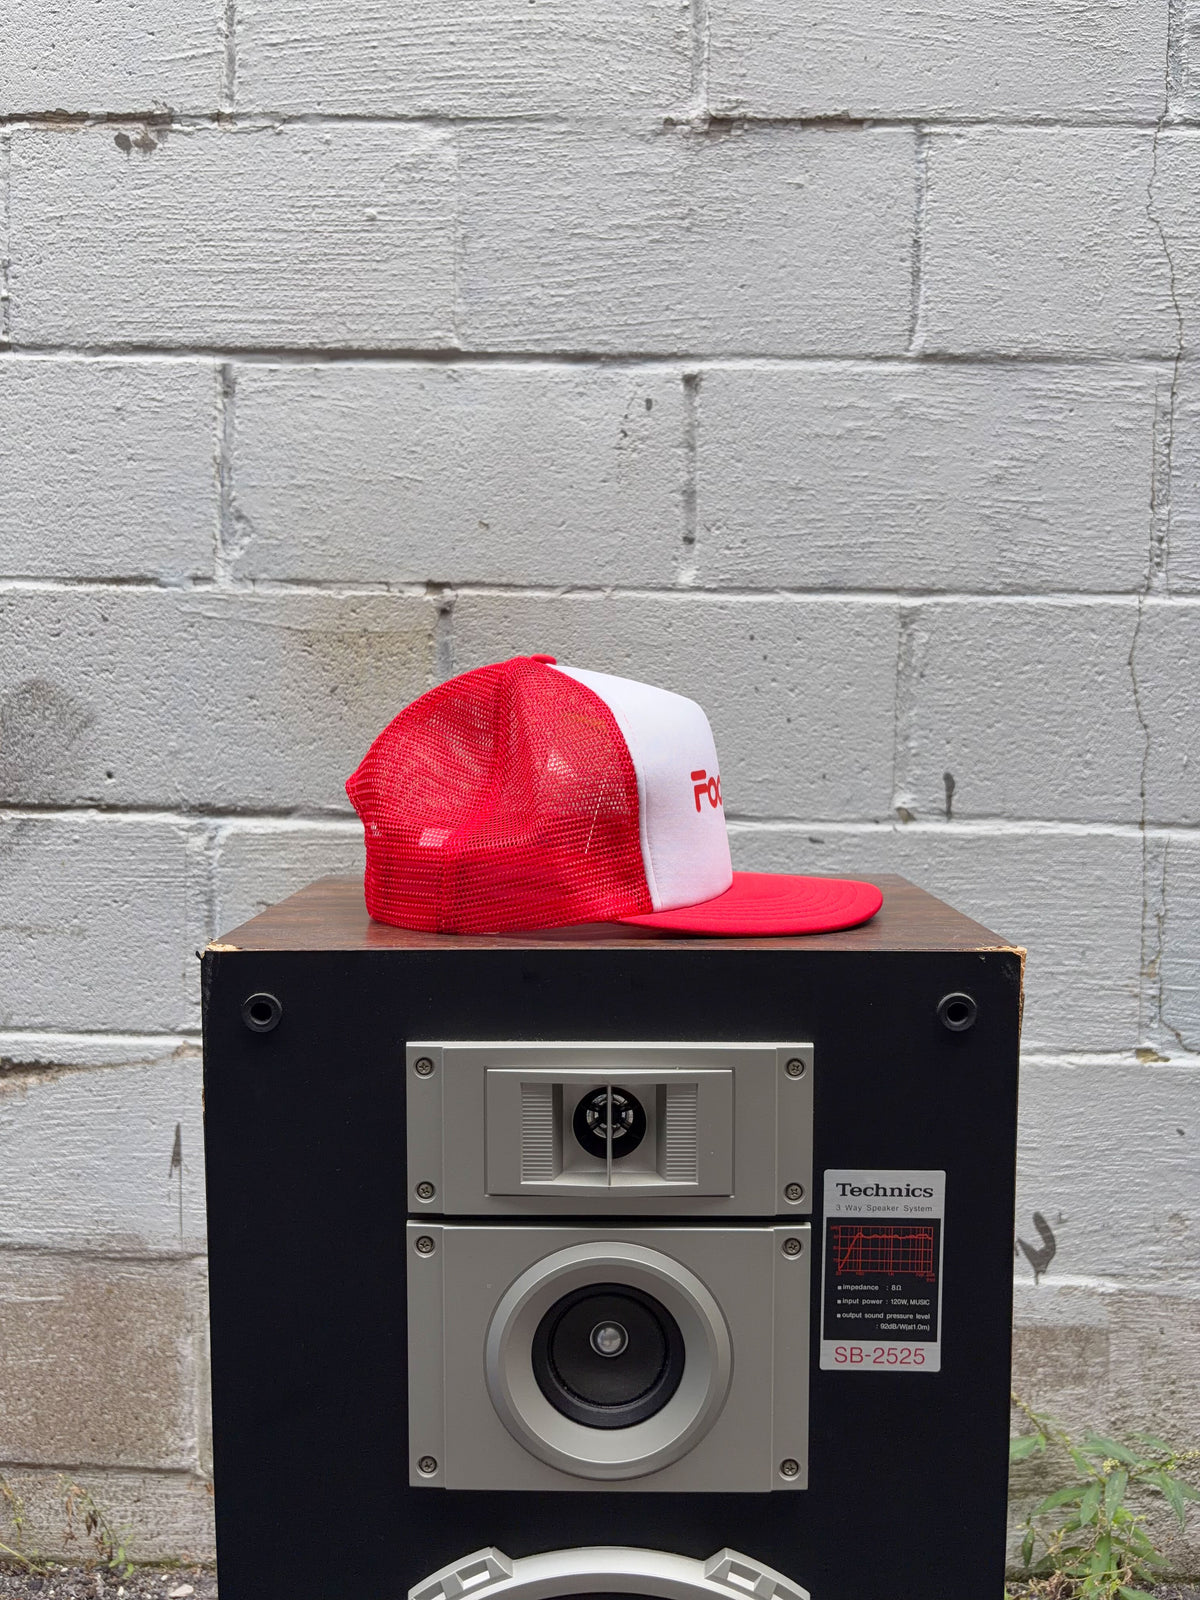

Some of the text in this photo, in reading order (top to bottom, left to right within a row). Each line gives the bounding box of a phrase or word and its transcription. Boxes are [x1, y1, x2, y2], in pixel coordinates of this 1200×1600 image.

[835, 1182, 934, 1198] Technics
[835, 1204, 933, 1213] 3 Way Speaker System
[834, 1347, 926, 1365] SB-2525
